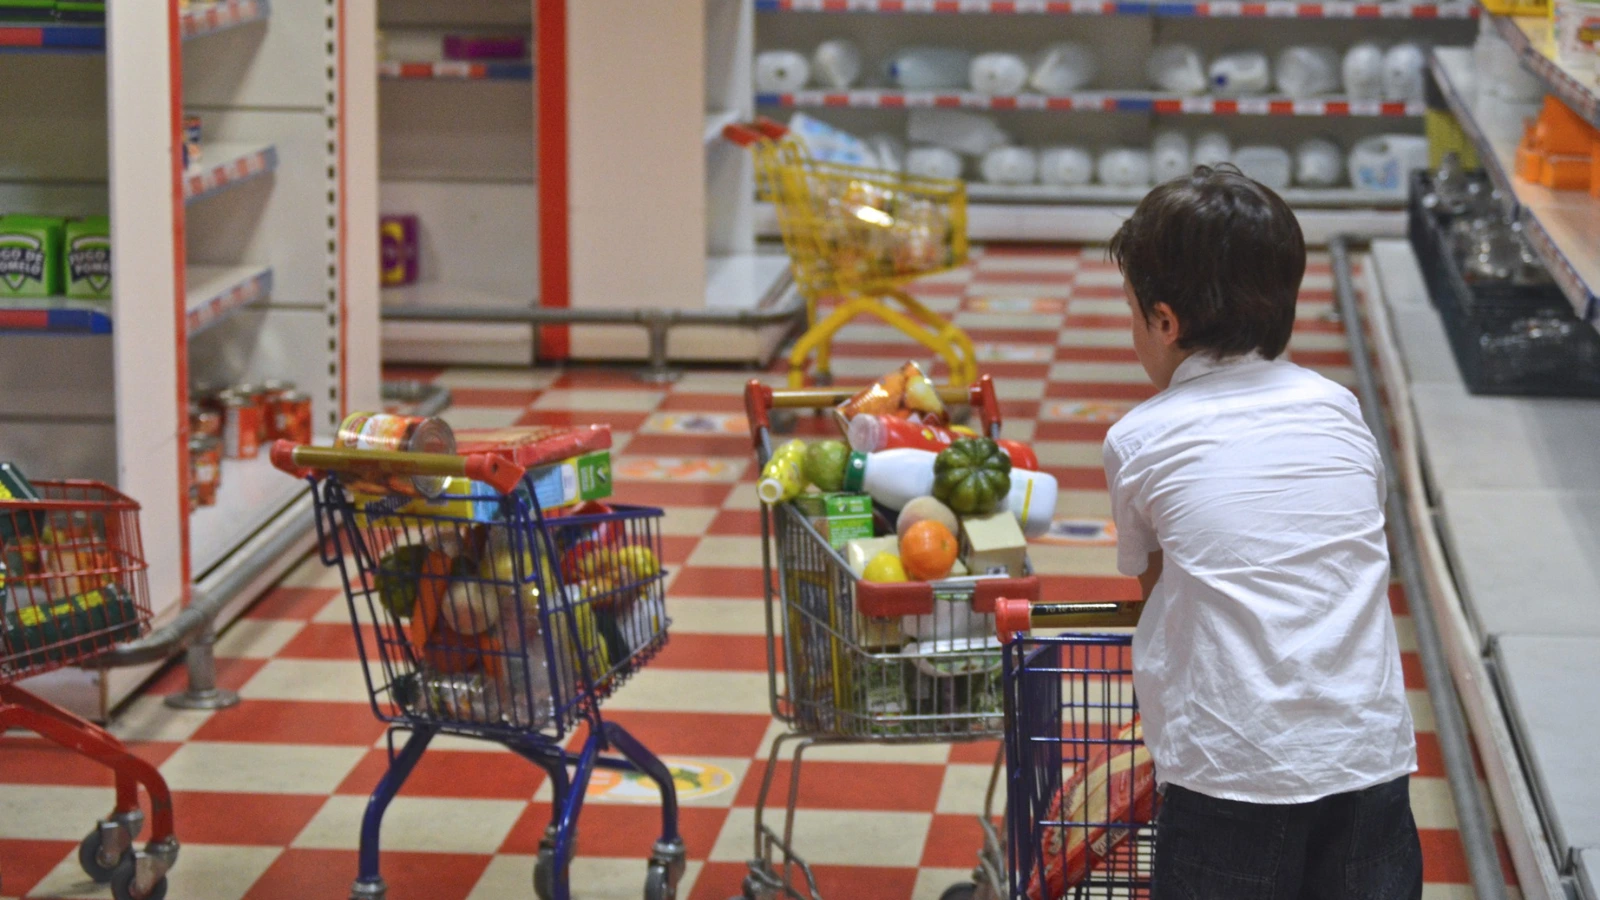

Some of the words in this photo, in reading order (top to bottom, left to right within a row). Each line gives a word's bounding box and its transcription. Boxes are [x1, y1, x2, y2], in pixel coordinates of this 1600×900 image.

[0, 249, 21, 261] GO
[25, 251, 43, 265] DE
[0, 260, 41, 275] OMELO
